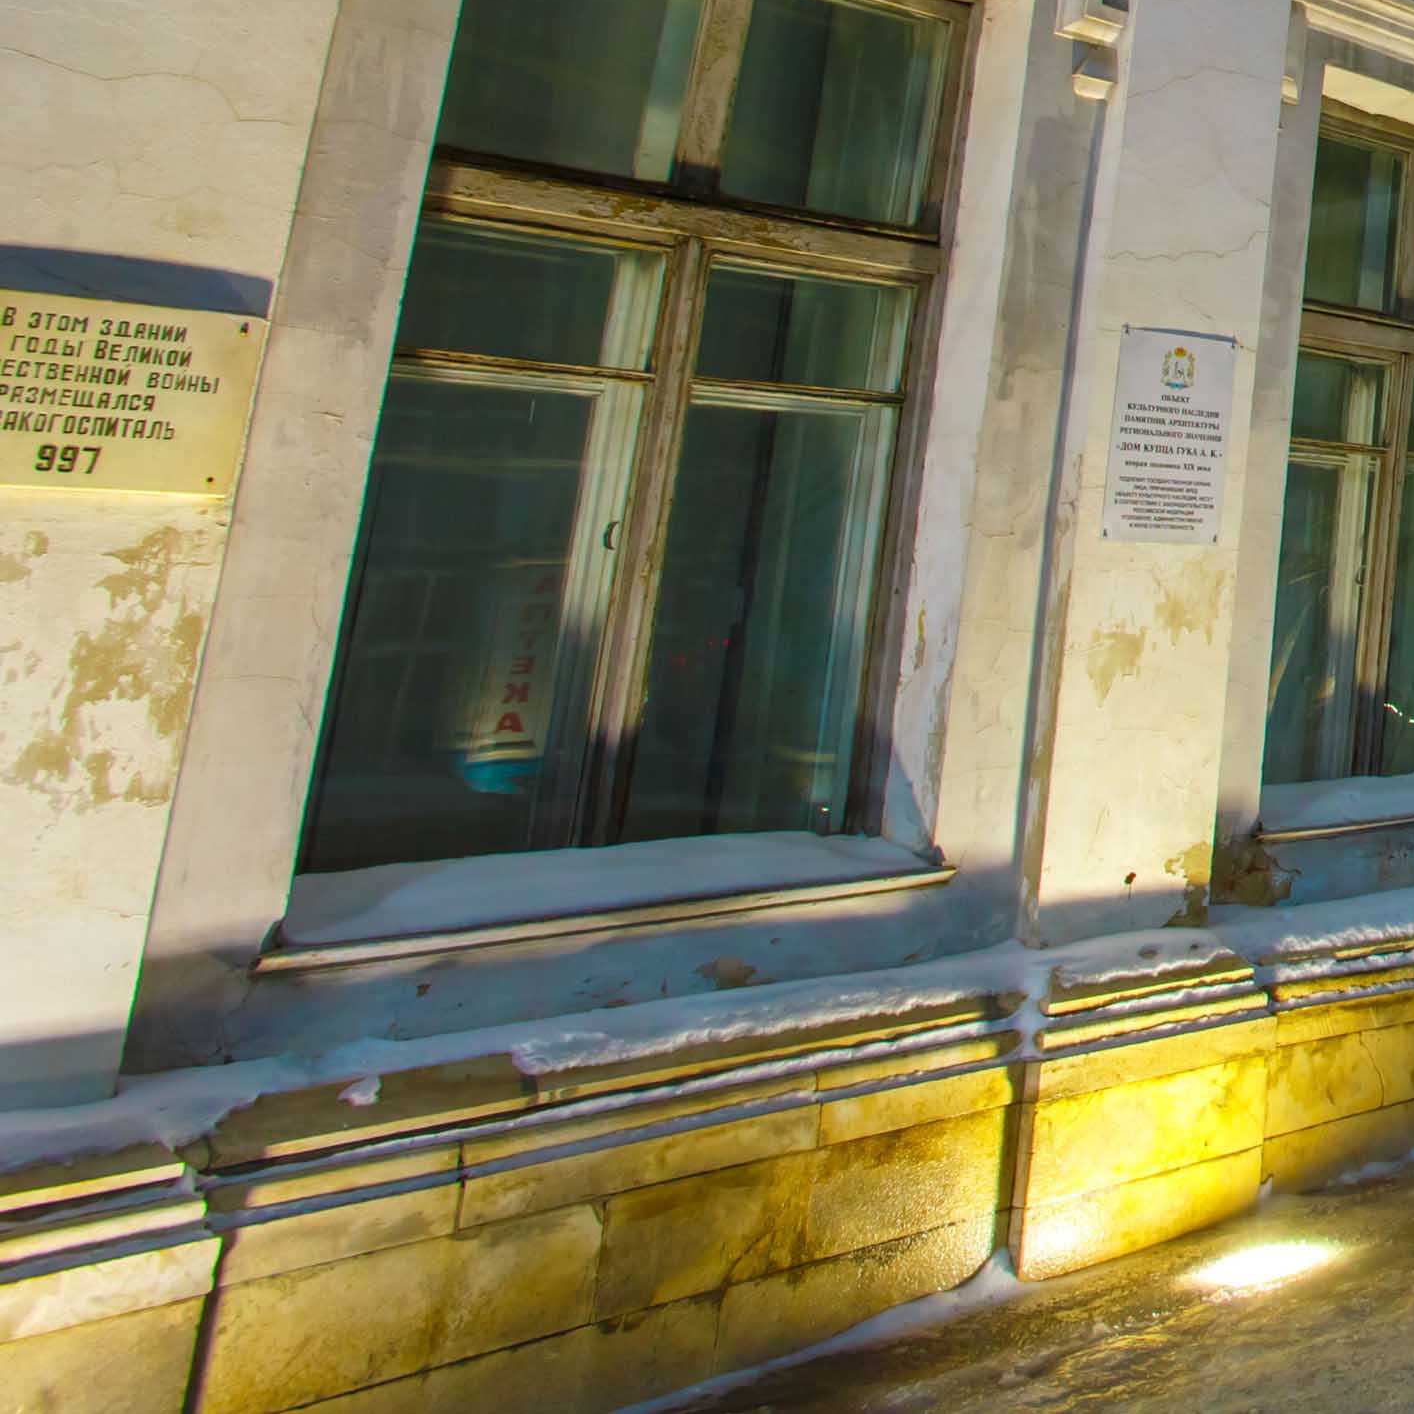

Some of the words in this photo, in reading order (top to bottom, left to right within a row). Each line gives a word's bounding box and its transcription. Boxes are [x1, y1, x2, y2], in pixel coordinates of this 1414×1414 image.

[1, 306, 17, 327] В
[27, 311, 90, 334] ЭТОМ
[98, 318, 188, 343] ЗДАНИИ
[9, 334, 83, 358] ГОДЫ
[94, 339, 194, 368] ВЕЛИКОЙ
[0, 358, 131, 387] ЕСТВЕННОЙ
[145, 369, 221, 395] ВОЙНЫ
[1161, 394, 1190, 404] ОБЪЕКТ
[0, 410, 176, 440] АКОГОСПИТАЛЬ
[34, 444, 102, 475] 997
